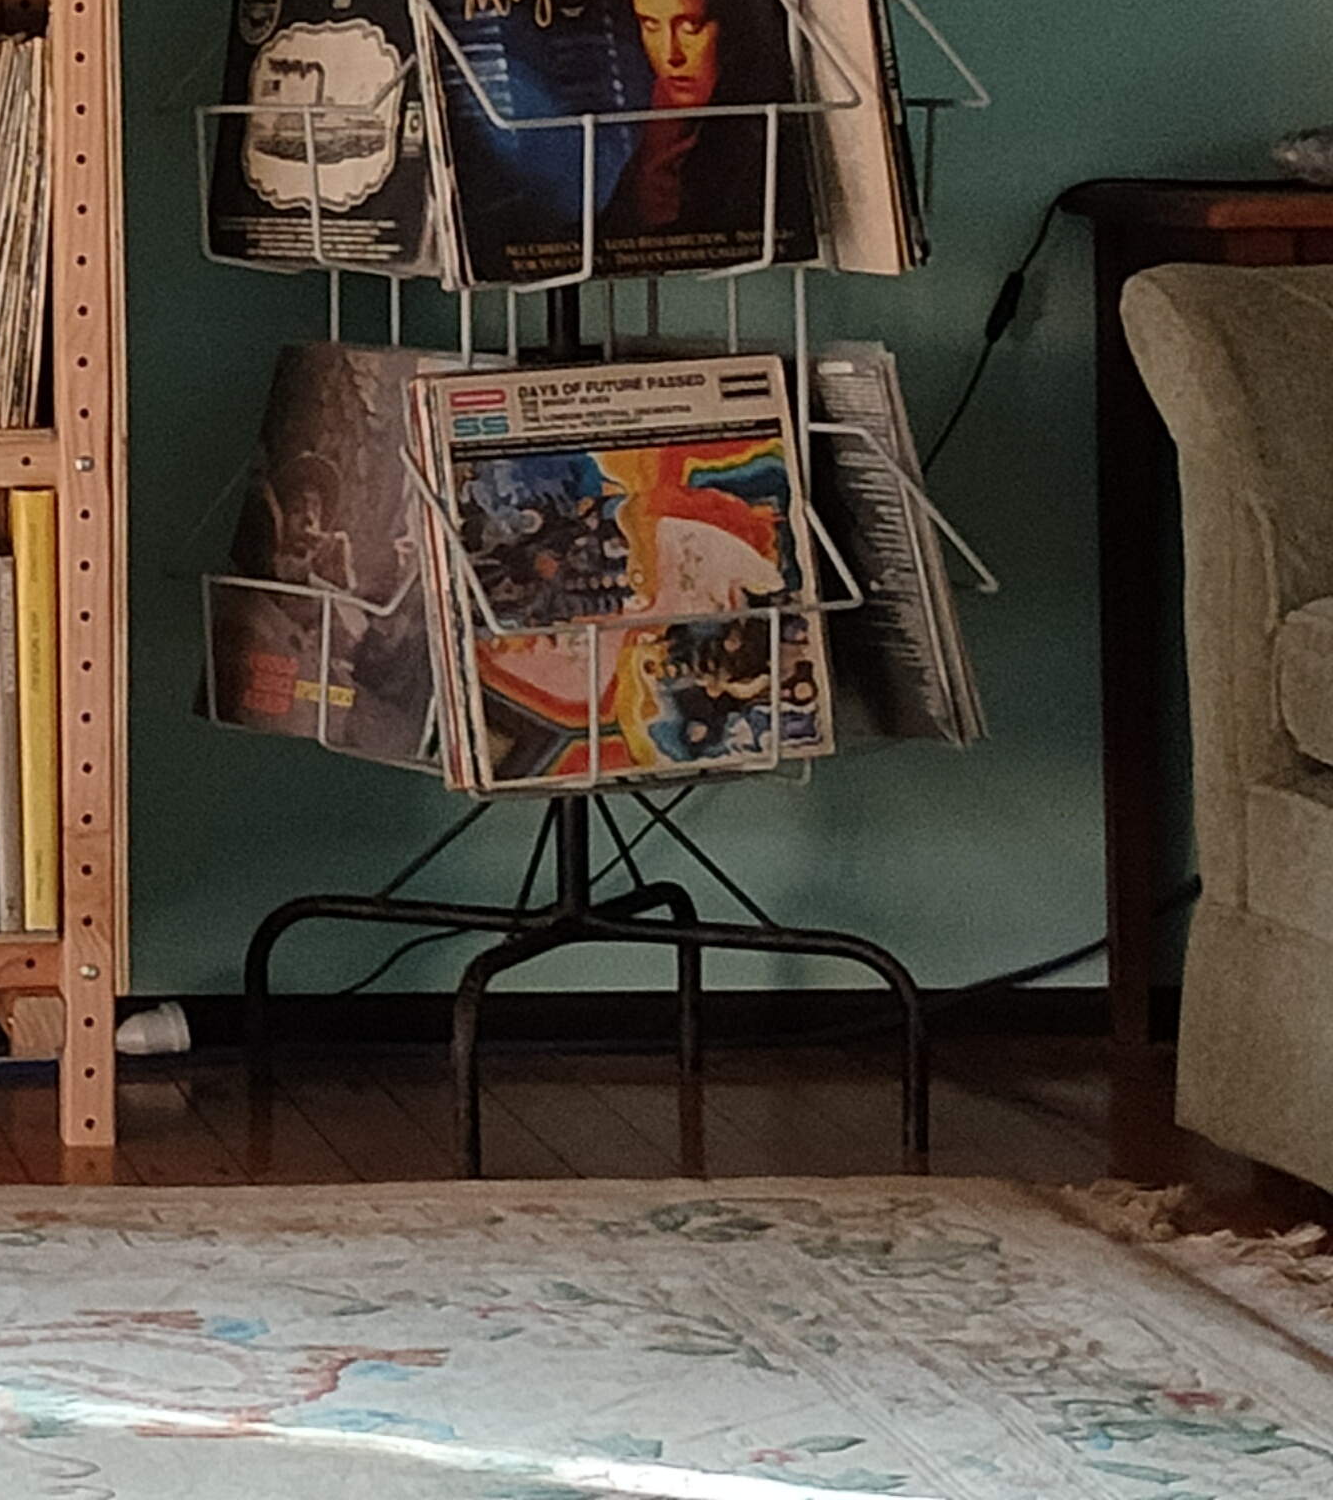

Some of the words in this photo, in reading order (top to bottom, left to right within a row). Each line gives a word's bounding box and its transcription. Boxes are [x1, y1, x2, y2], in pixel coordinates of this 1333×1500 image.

[517, 382, 558, 400] DAYS
[562, 381, 582, 396] OF
[585, 377, 644, 394] FUTURE
[646, 373, 707, 389] PASSED
